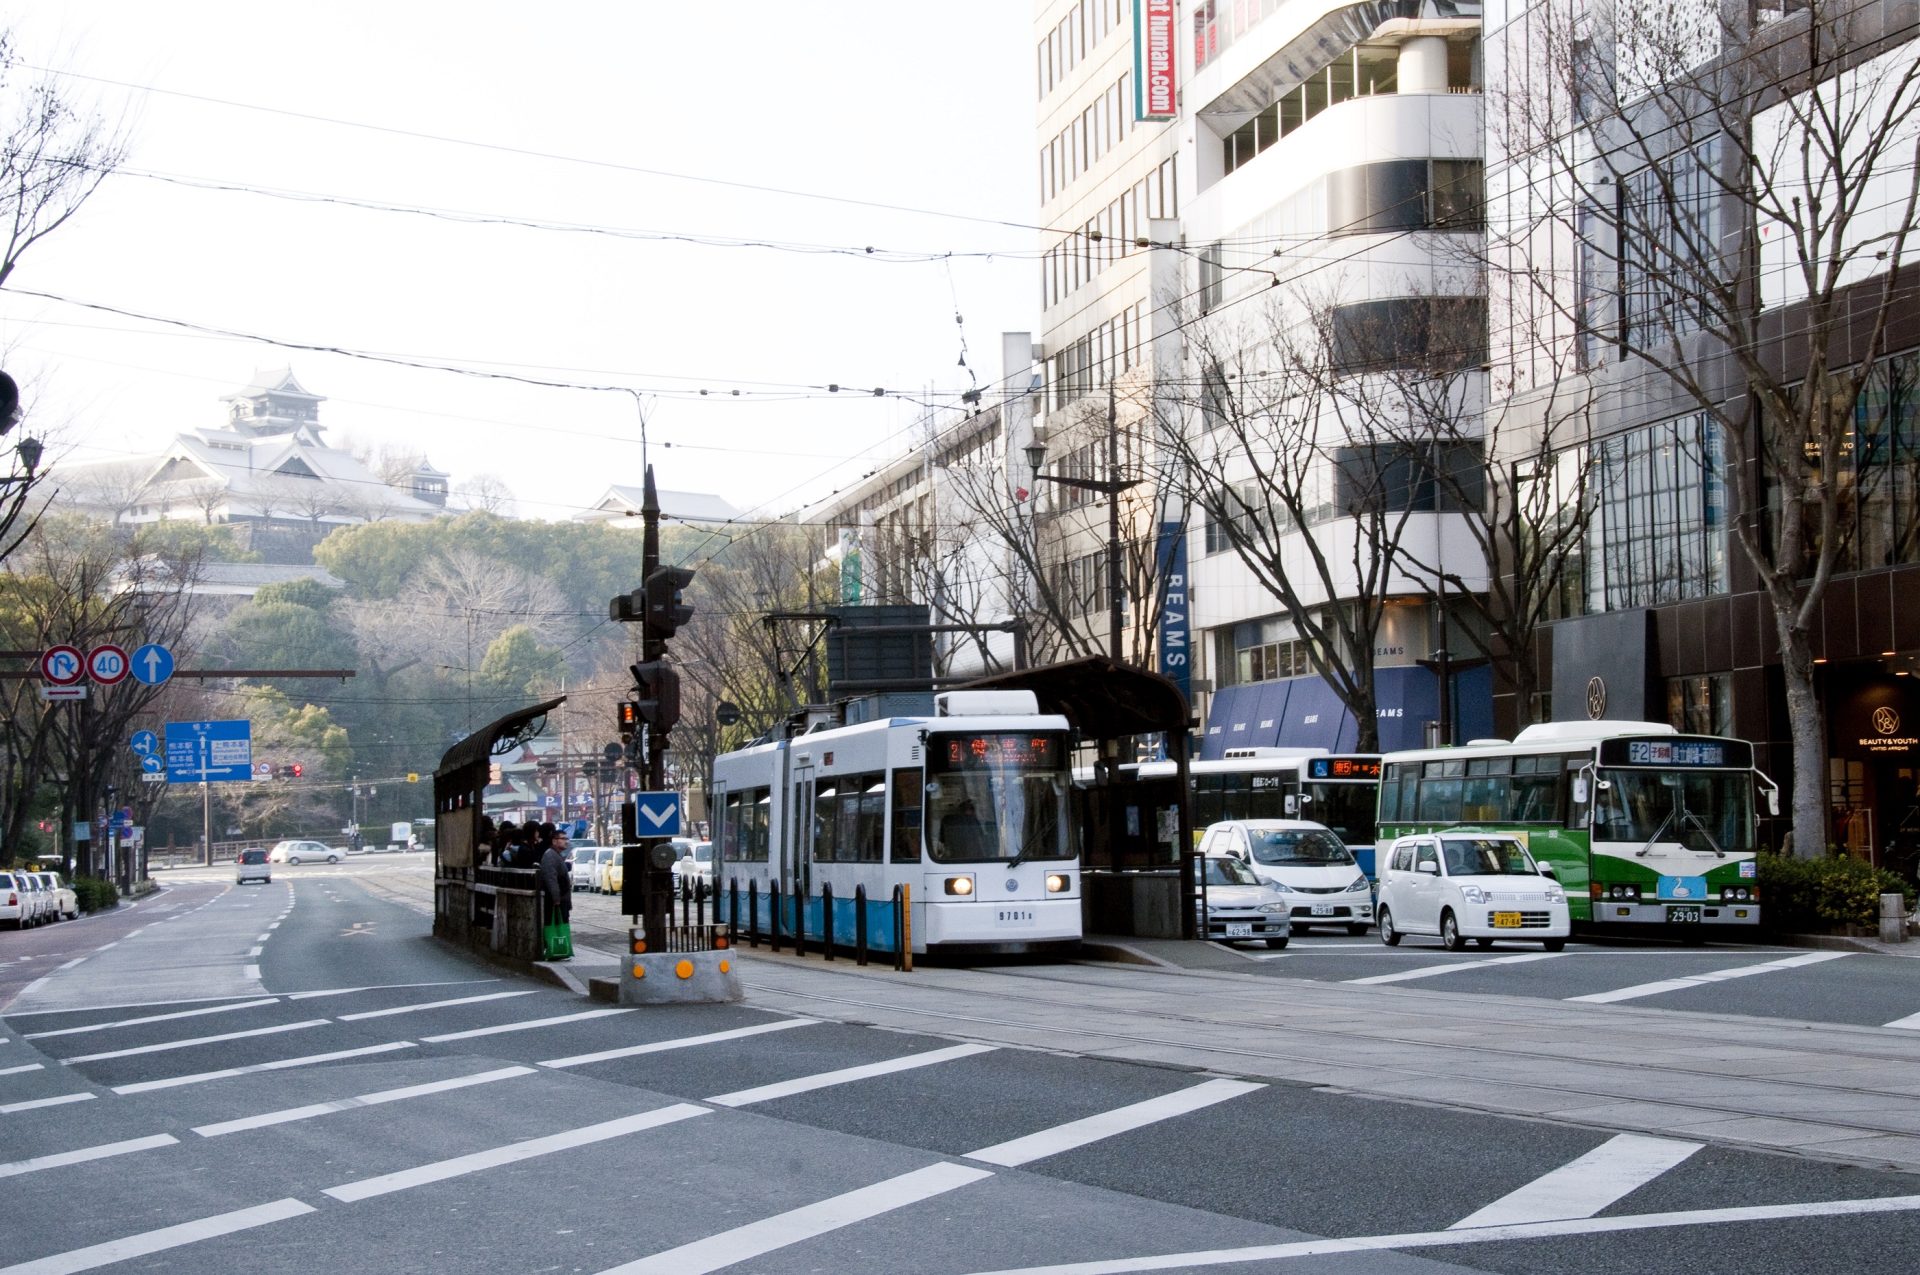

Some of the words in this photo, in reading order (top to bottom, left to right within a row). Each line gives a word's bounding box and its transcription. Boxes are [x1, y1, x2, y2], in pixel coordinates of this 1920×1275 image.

[1150, 15, 1170, 111] human.com
[96, 655, 120, 673] 40
[1672, 911, 1699, 922] 29-03
